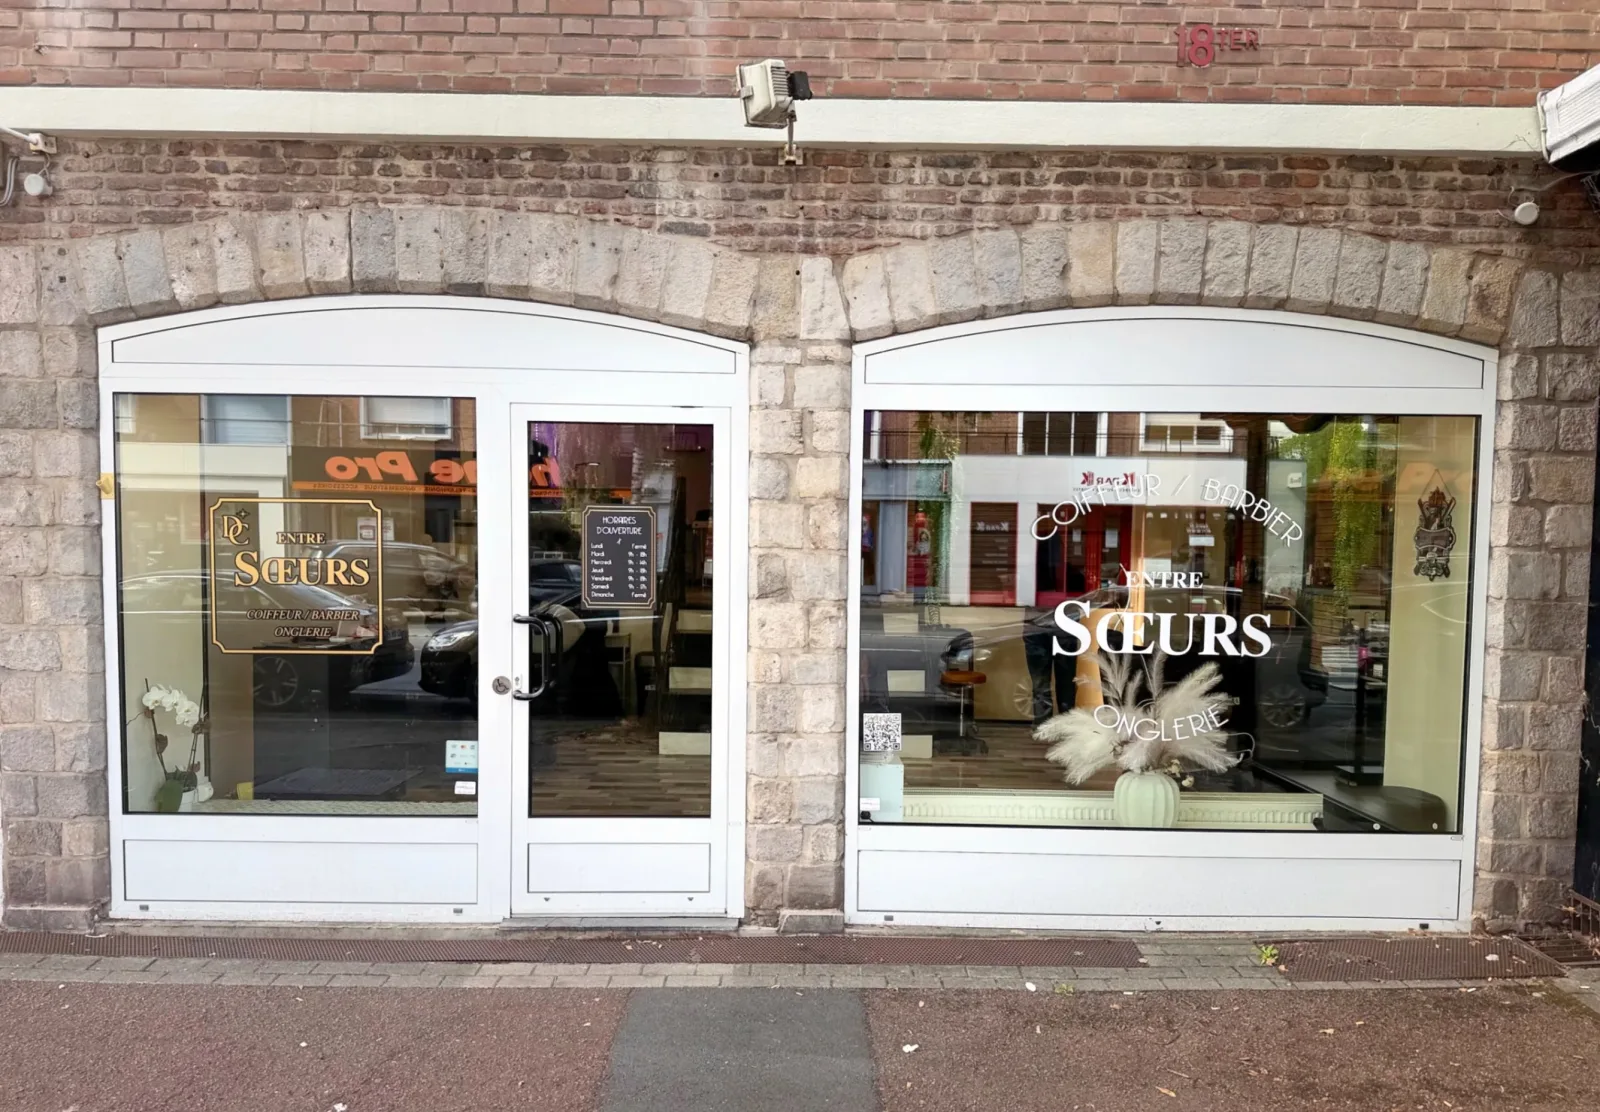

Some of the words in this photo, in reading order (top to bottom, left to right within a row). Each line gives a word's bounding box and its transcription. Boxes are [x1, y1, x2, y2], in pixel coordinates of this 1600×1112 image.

[1174, 24, 1215, 67] 18
[1217, 29, 1258, 51] TER
[602, 516, 637, 524] HORAIRES
[1031, 473, 1162, 541] COIFFEUR
[1203, 478, 1303, 548] BARBIER
[276, 532, 326, 545] ENTRE
[234, 551, 370, 587] SŒURS
[1125, 571, 1204, 589] ENTRE
[246, 609, 302, 621] COIFFEUR
[311, 609, 360, 621] BARBIER
[274, 626, 332, 638] ONGLERIE
[1052, 600, 1272, 658] SŒURS
[1094, 704, 1228, 742] ONGLERIE
